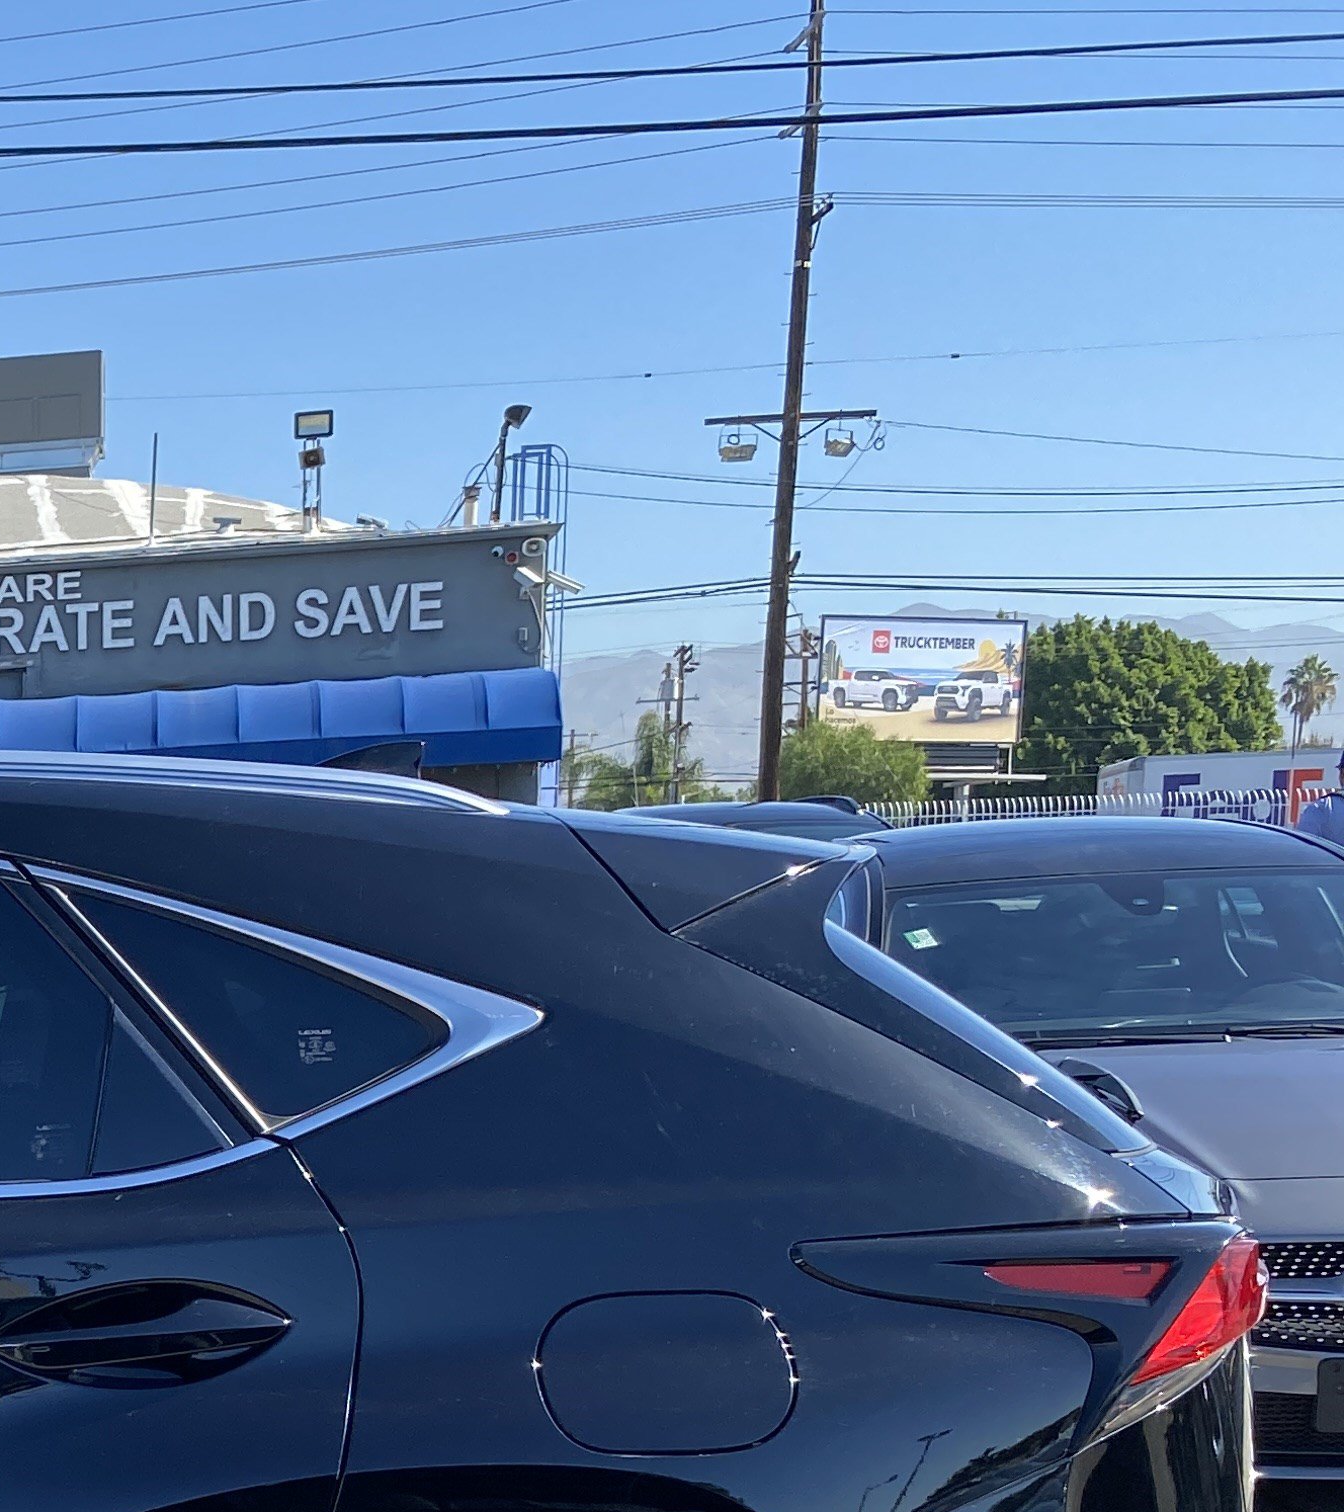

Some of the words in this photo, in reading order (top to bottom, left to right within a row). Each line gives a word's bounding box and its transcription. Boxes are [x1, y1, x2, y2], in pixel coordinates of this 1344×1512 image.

[153, 591, 277, 646] AND
[293, 581, 445, 638] SAVE
[894, 636, 975, 650] TRUCKTEMBER
